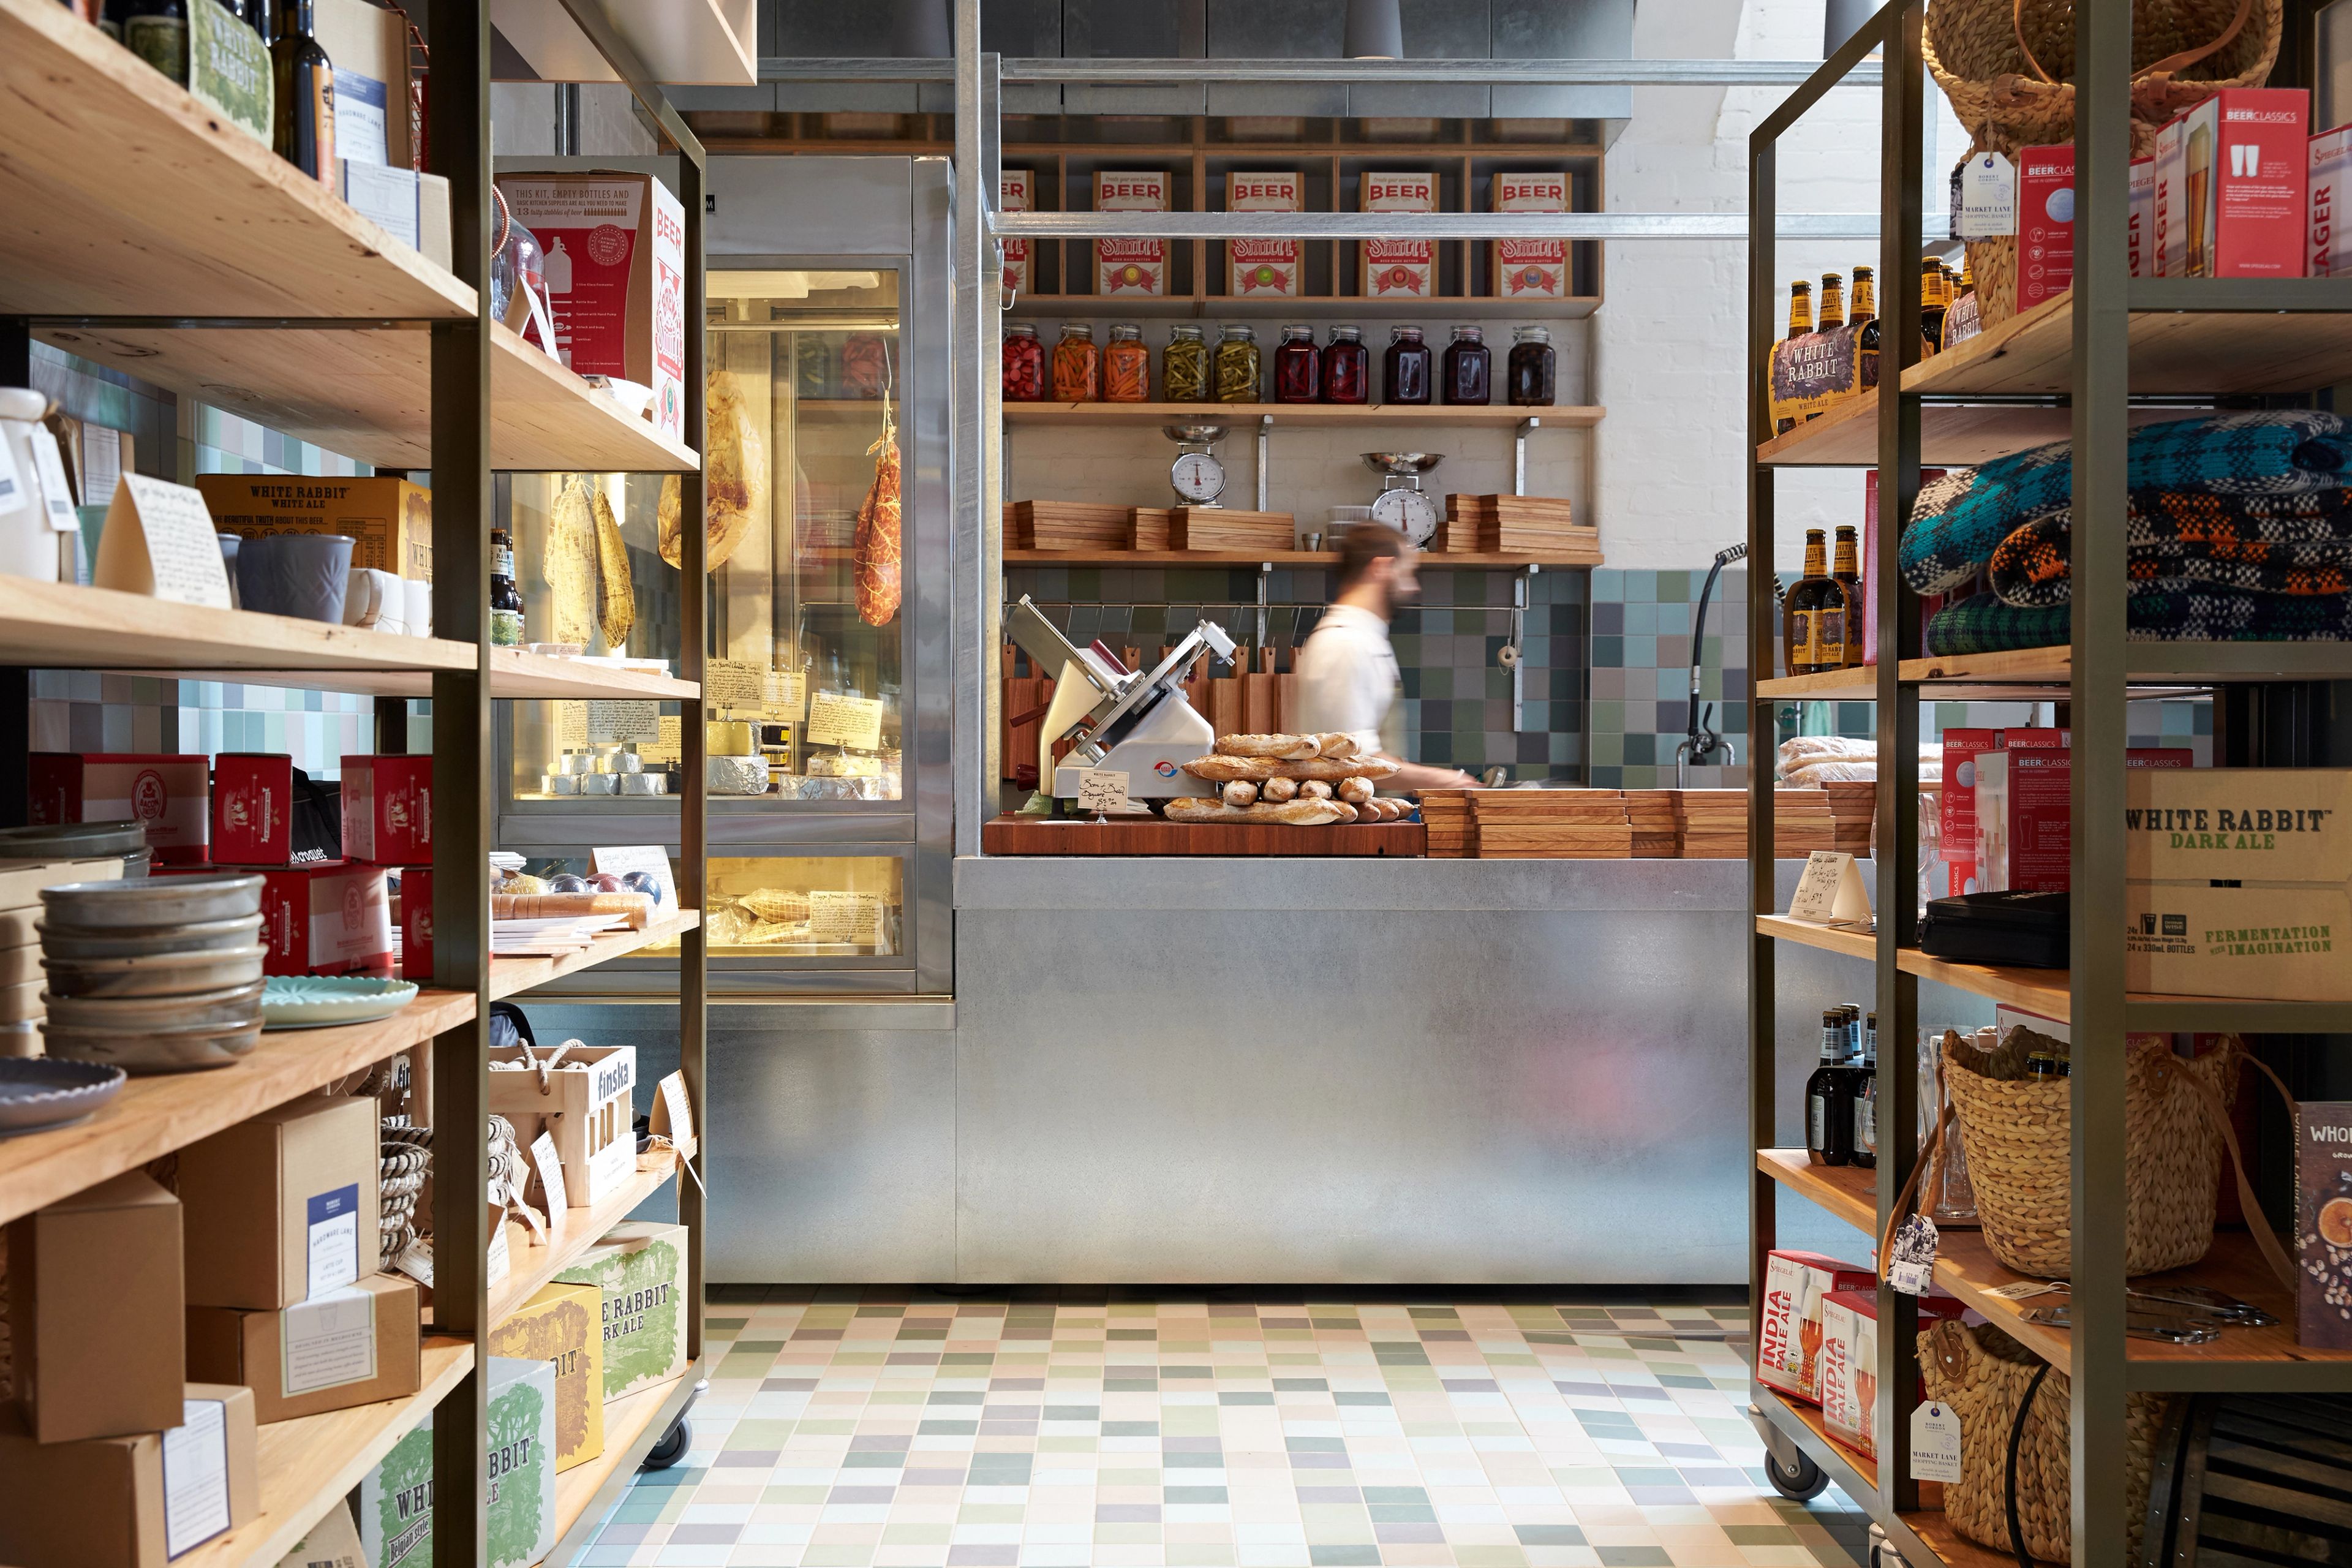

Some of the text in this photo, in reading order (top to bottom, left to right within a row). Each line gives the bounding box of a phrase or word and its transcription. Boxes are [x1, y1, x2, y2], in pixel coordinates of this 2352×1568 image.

[210, 42, 258, 95] RABBIT
[2226, 111, 2297, 122] BEERCLASSICS
[2028, 165, 2075, 175] BEERCLAS
[516, 189, 532, 198] THIS
[535, 189, 550, 199] KIT,
[552, 190, 576, 198] EMPTY
[579, 190, 611, 198] BOTTLES
[1102, 184, 1161, 200] BEER
[1235, 185, 1294, 201] BEER
[1370, 186, 1428, 202] BEER
[1503, 186, 1562, 202] BEER
[657, 206, 682, 258] BEER
[2157, 179, 2167, 277] LAGER
[2313, 185, 2331, 277] AGER
[1956, 301, 1978, 325] WHITE
[1952, 318, 1980, 345] RABBIT
[1793, 342, 1834, 363] WHITE
[1788, 363, 1838, 382] RABBIT
[1798, 401, 1817, 410] WHITE
[251, 486, 292, 499] WHITE
[271, 499, 325, 508] WHITE ALE
[224, 515, 254, 524] BEAUTIFUL
[256, 516, 274, 525] TRUTH
[412, 543, 433, 568] WHIT
[140, 799, 159, 807] BACON
[2126, 809, 2323, 832] WHITE RABBIT
[2170, 833, 2275, 850] DARK ALE
[298, 846, 327, 863] croquet
[2205, 925, 2331, 943] FERMENTATION
[2143, 944, 2165, 953] 330mL
[2166, 945, 2195, 954] BOTTLES
[2228, 940, 2332, 957] IMAGINATION
[598, 1061, 629, 1102] finska
[2310, 1126, 2352, 1144] WHO
[313, 1229, 339, 1248] HARDWARE
[1770, 1260, 1795, 1278] SPIEGELAU
[613, 1283, 669, 1320] RABBIT
[1825, 1305, 1846, 1324] SPIEGELAU
[603, 1315, 644, 1341] RK ALE
[1762, 1290, 1782, 1368] INDIA
[1776, 1291, 1792, 1372] PALE ALE
[1825, 1337, 1838, 1421] INDIA
[1838, 1379, 1846, 1426] PALE
[489, 1438, 532, 1479] BBIT
[396, 1479, 433, 1521] WHI
[390, 1520, 429, 1562] Belgian style
